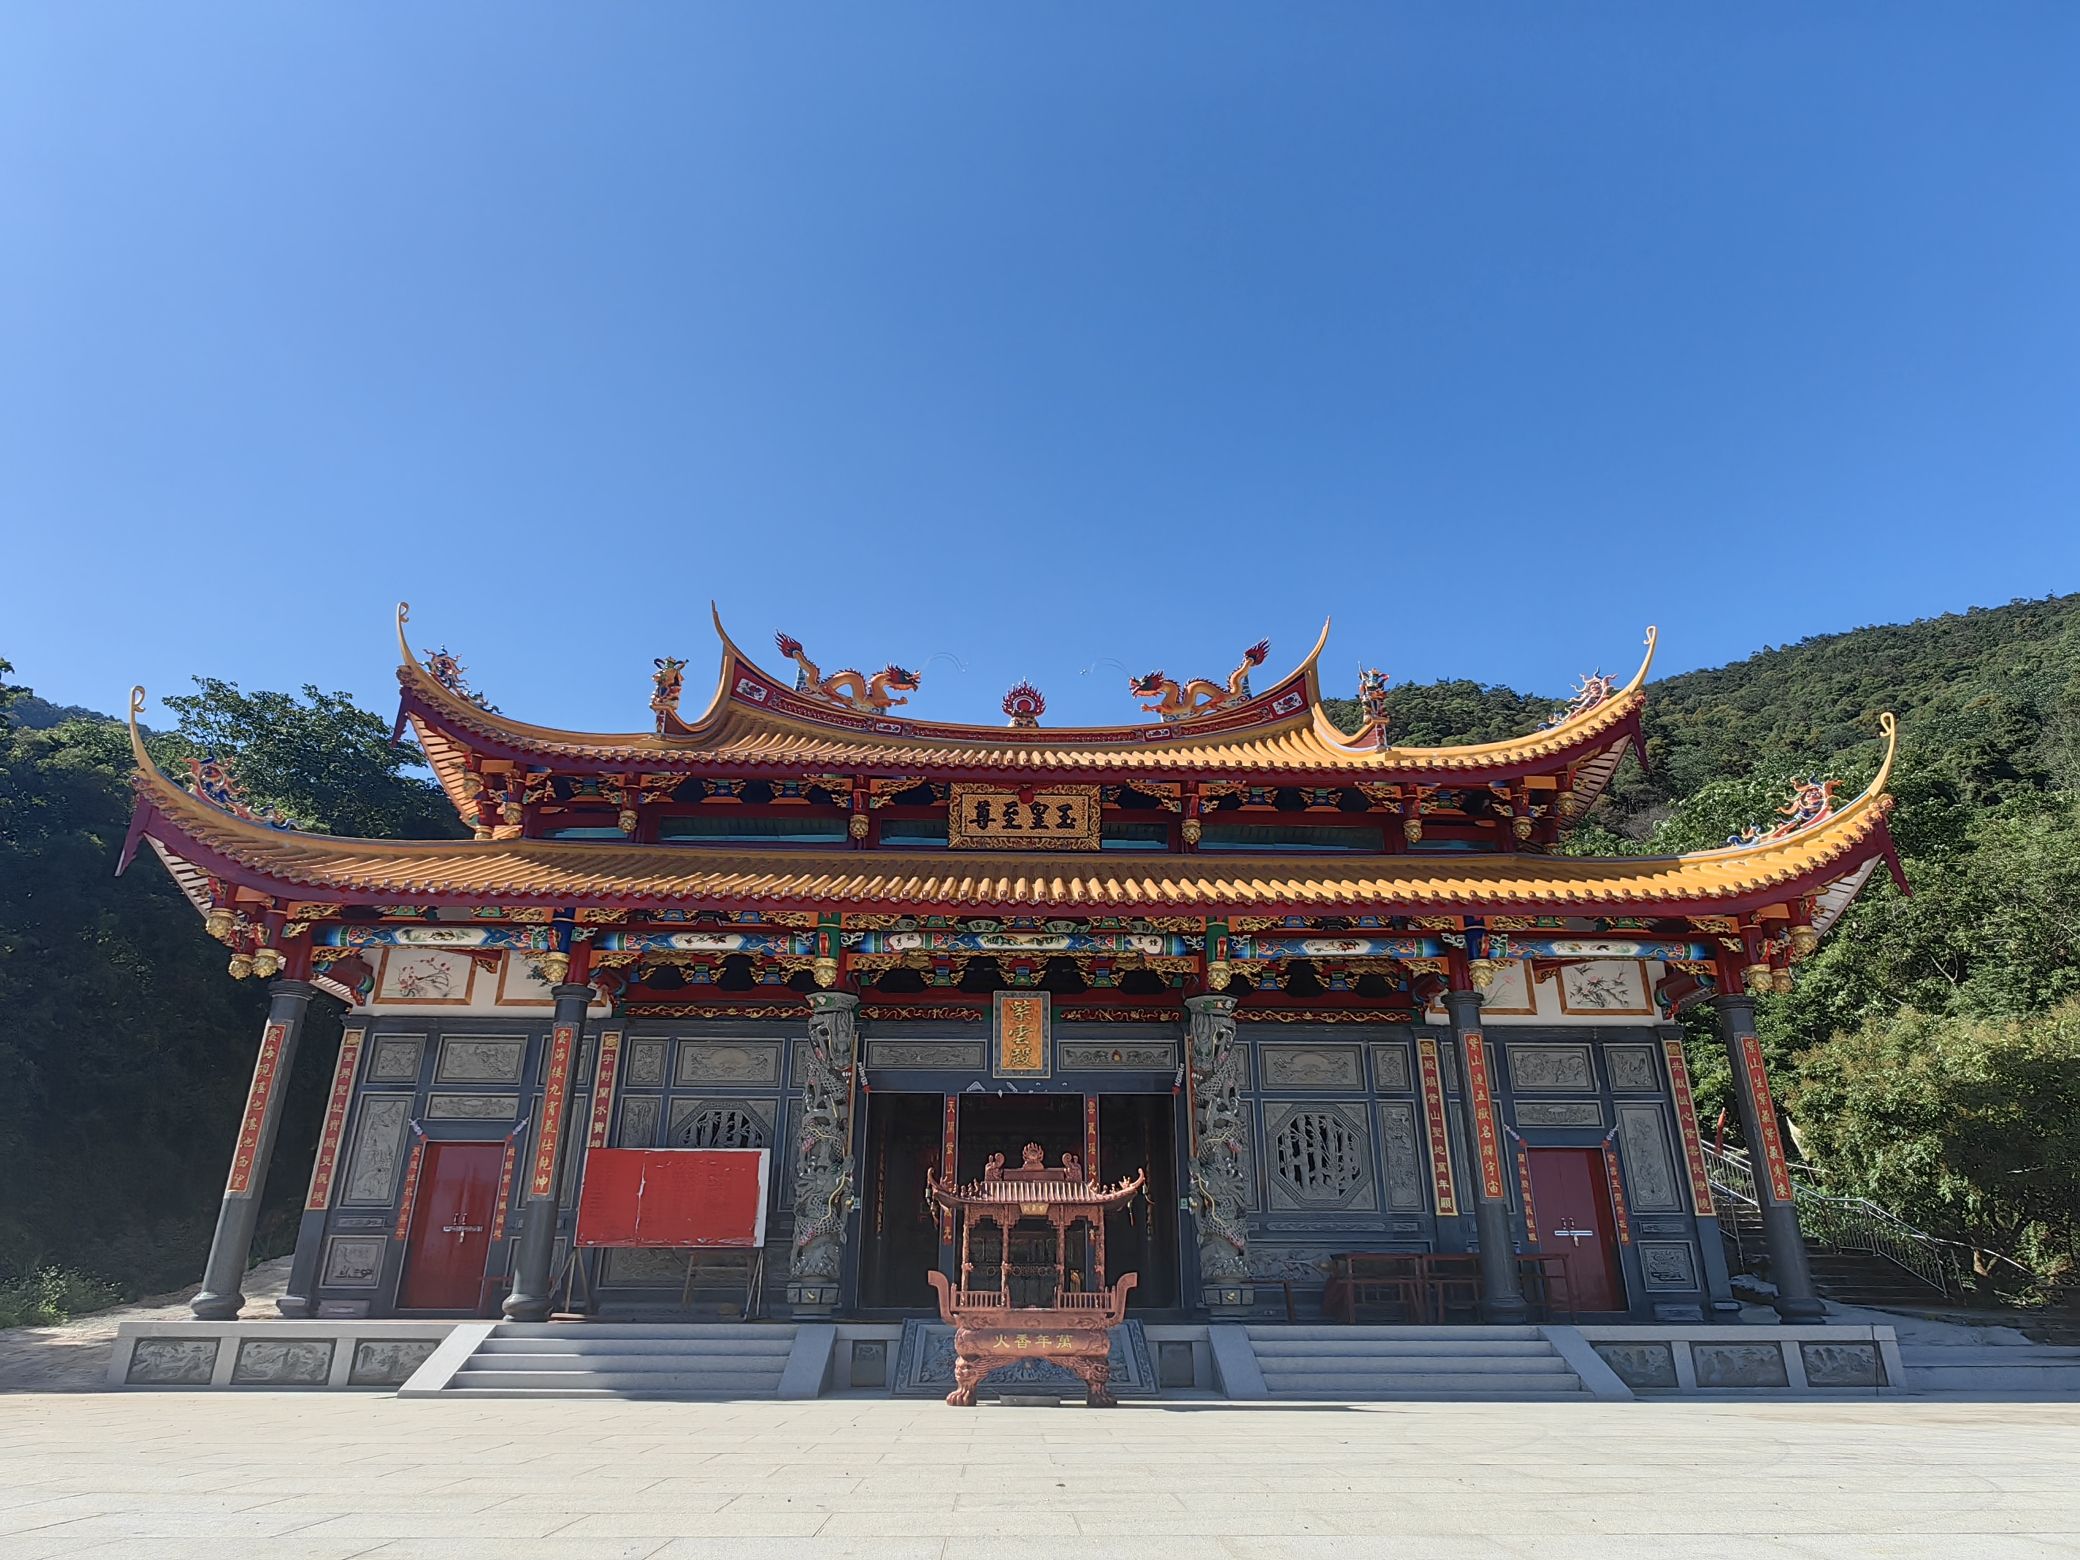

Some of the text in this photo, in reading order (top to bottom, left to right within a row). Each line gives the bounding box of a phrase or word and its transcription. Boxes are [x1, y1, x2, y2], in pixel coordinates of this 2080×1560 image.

[1008, 1000, 1036, 1067] 紫雲殿
[993, 1333, 1074, 1349] 萬年香火
